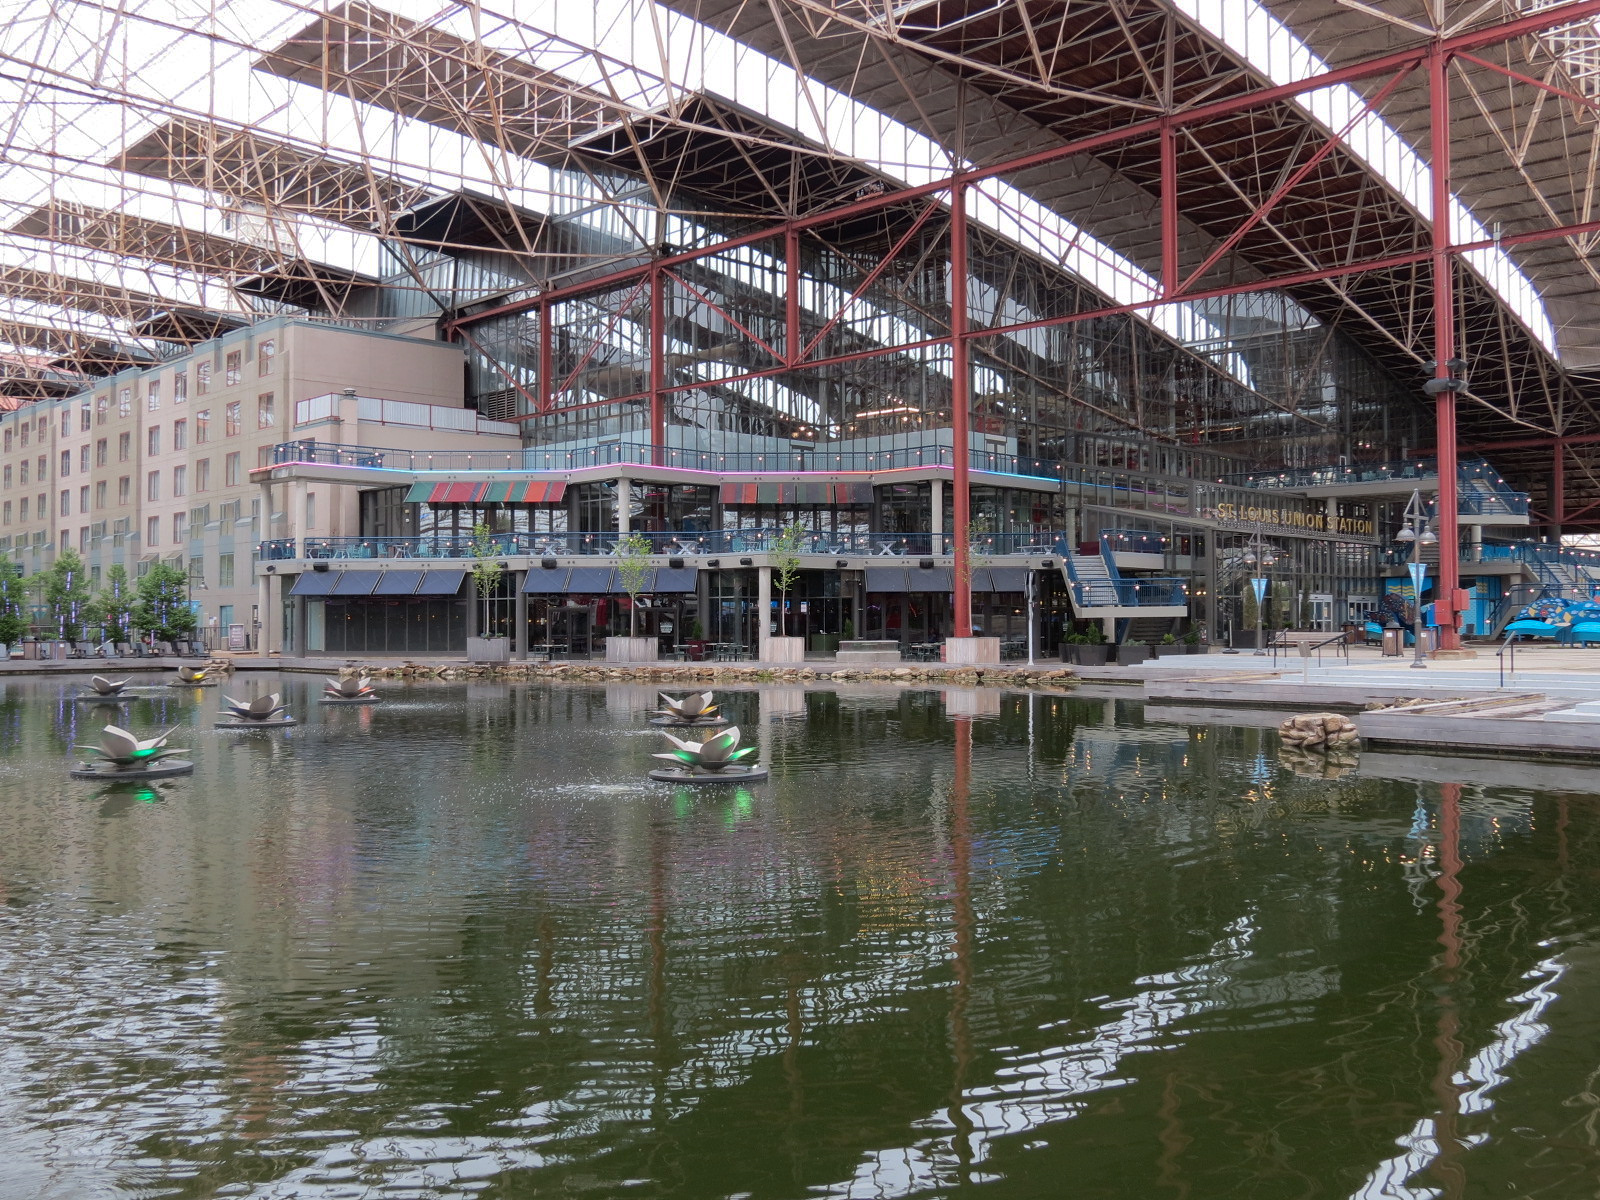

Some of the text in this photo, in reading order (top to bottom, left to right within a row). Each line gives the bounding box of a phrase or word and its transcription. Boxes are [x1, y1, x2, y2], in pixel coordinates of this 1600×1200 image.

[1217, 502, 1373, 534] ST. LOUIS UNION STATION
